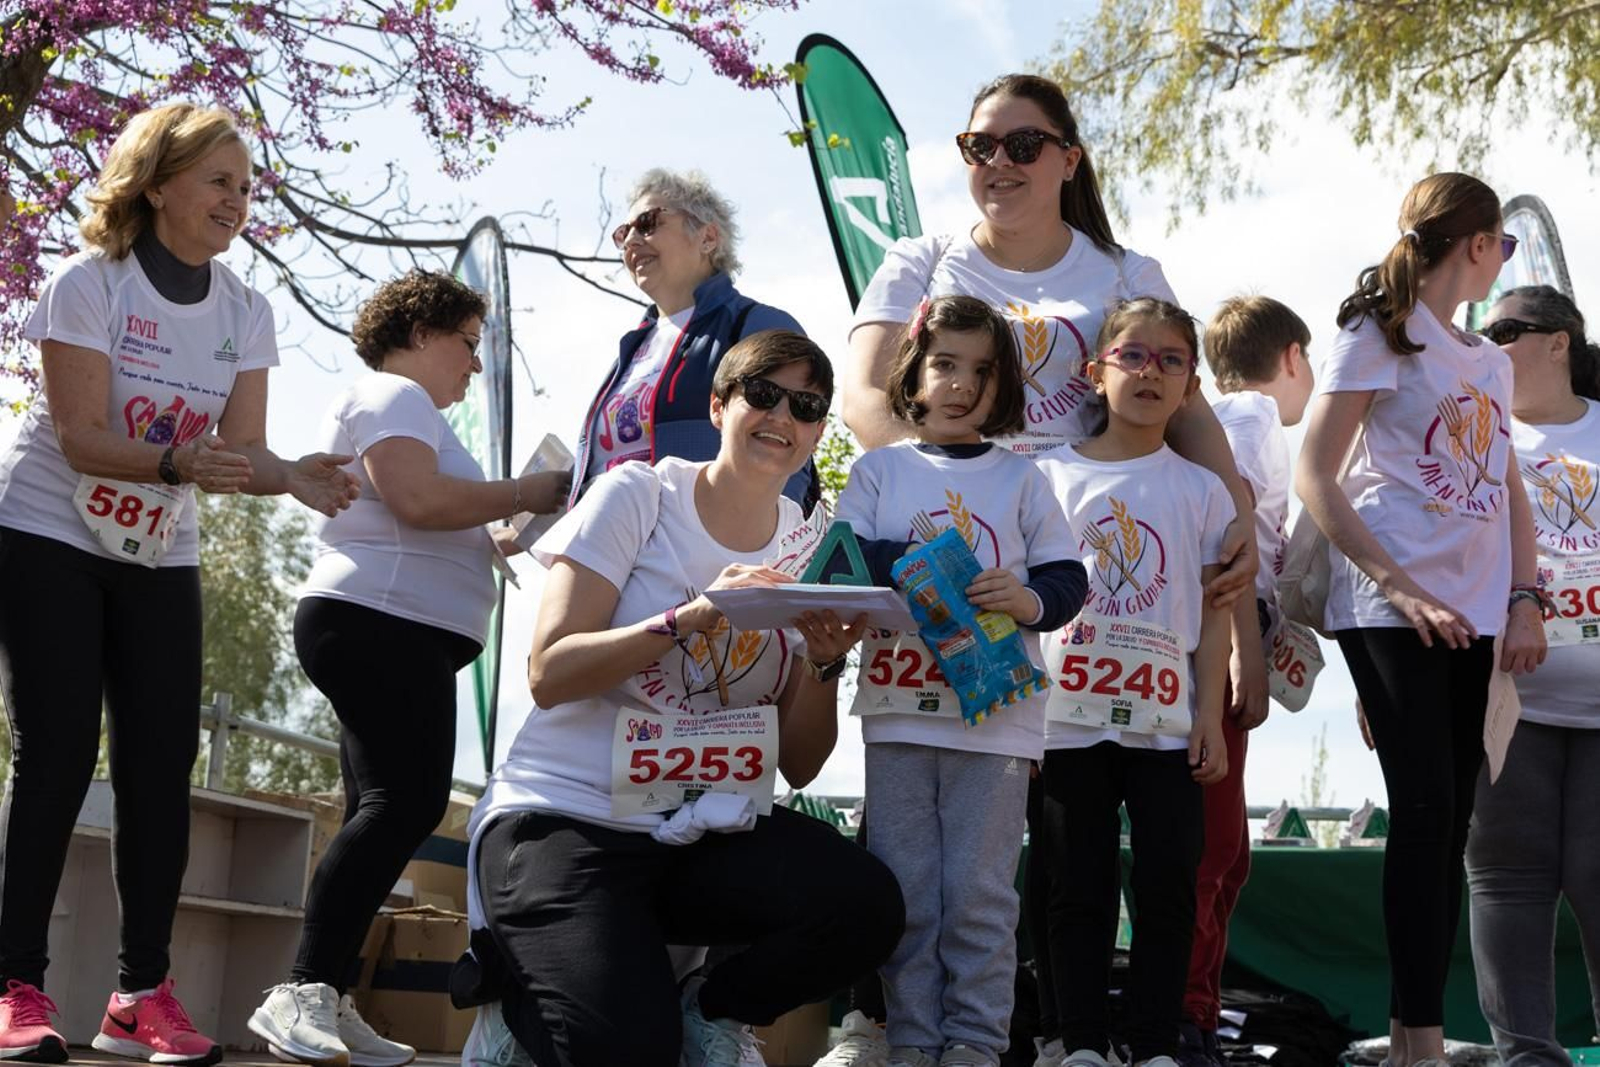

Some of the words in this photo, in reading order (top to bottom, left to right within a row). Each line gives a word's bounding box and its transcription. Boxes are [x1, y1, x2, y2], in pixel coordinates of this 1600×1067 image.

[86, 483, 165, 541] 581
[1059, 653, 1180, 706] 5249
[1111, 699, 1133, 708] SOFIA
[629, 746, 763, 784] 5253
